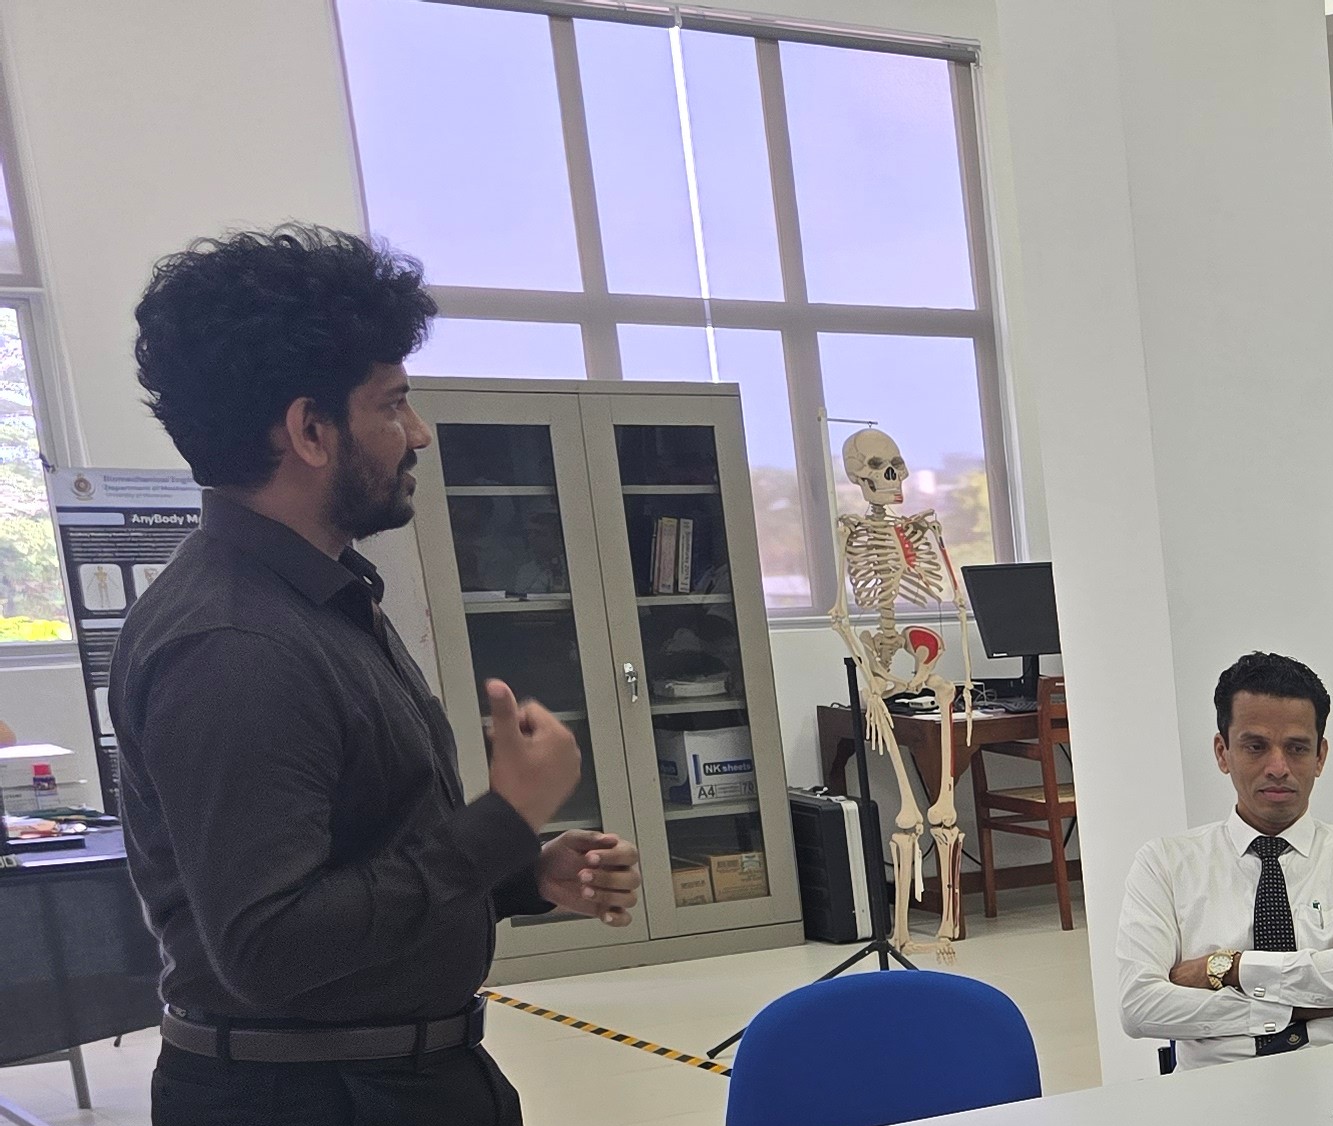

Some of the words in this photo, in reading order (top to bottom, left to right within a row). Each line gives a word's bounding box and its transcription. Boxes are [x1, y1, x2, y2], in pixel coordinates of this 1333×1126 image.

[131, 513, 184, 526] AnyBody
[705, 763, 721, 774] NK
[722, 762, 752, 773] sheets
[698, 784, 716, 799] A4
